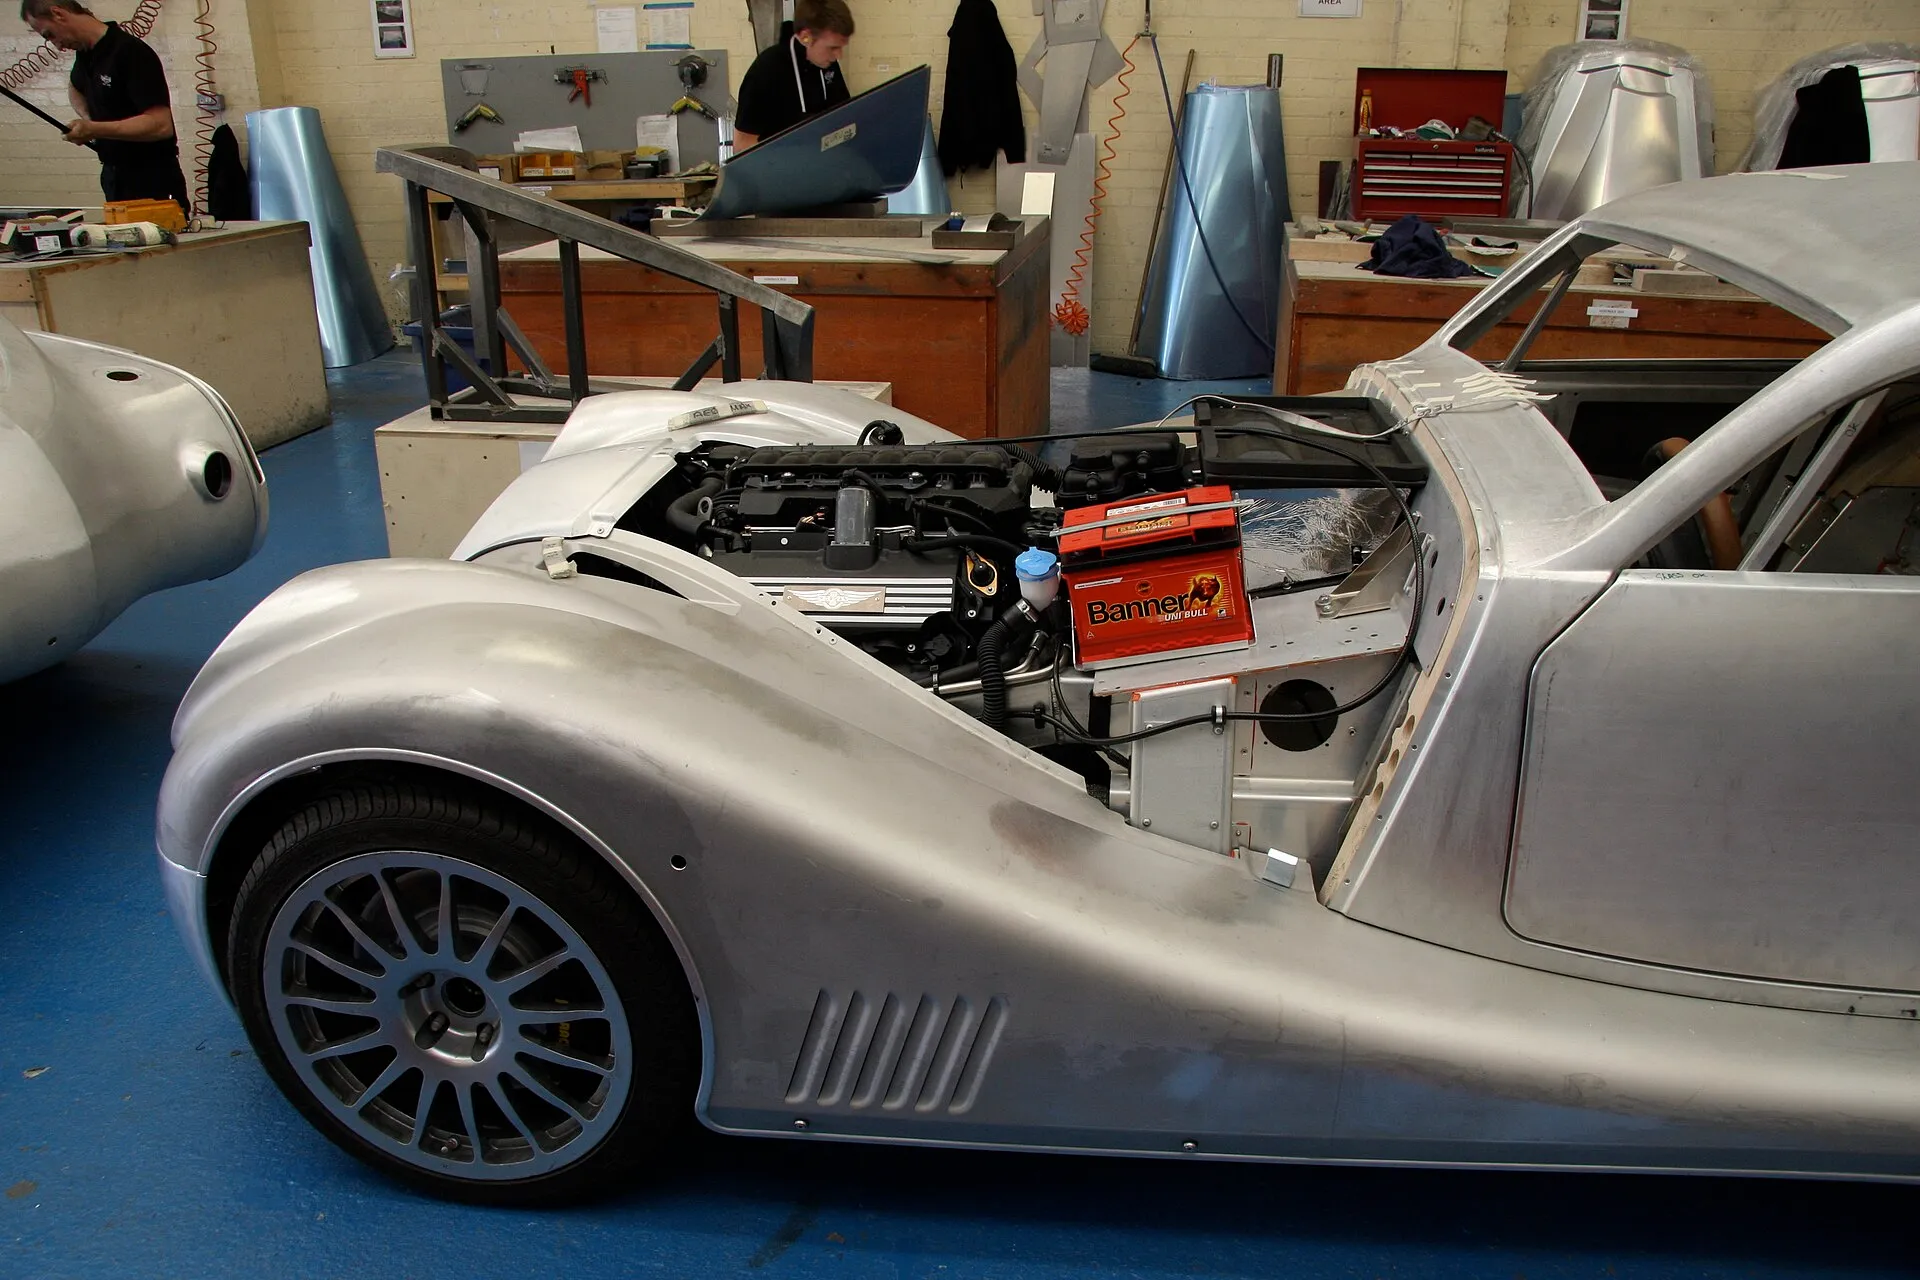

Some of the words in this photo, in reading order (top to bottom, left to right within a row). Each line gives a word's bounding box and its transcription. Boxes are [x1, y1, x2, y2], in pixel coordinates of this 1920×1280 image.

[1087, 593, 1189, 626] Banner
[1164, 612, 1183, 623] UNI
[1184, 608, 1209, 620] BULL
